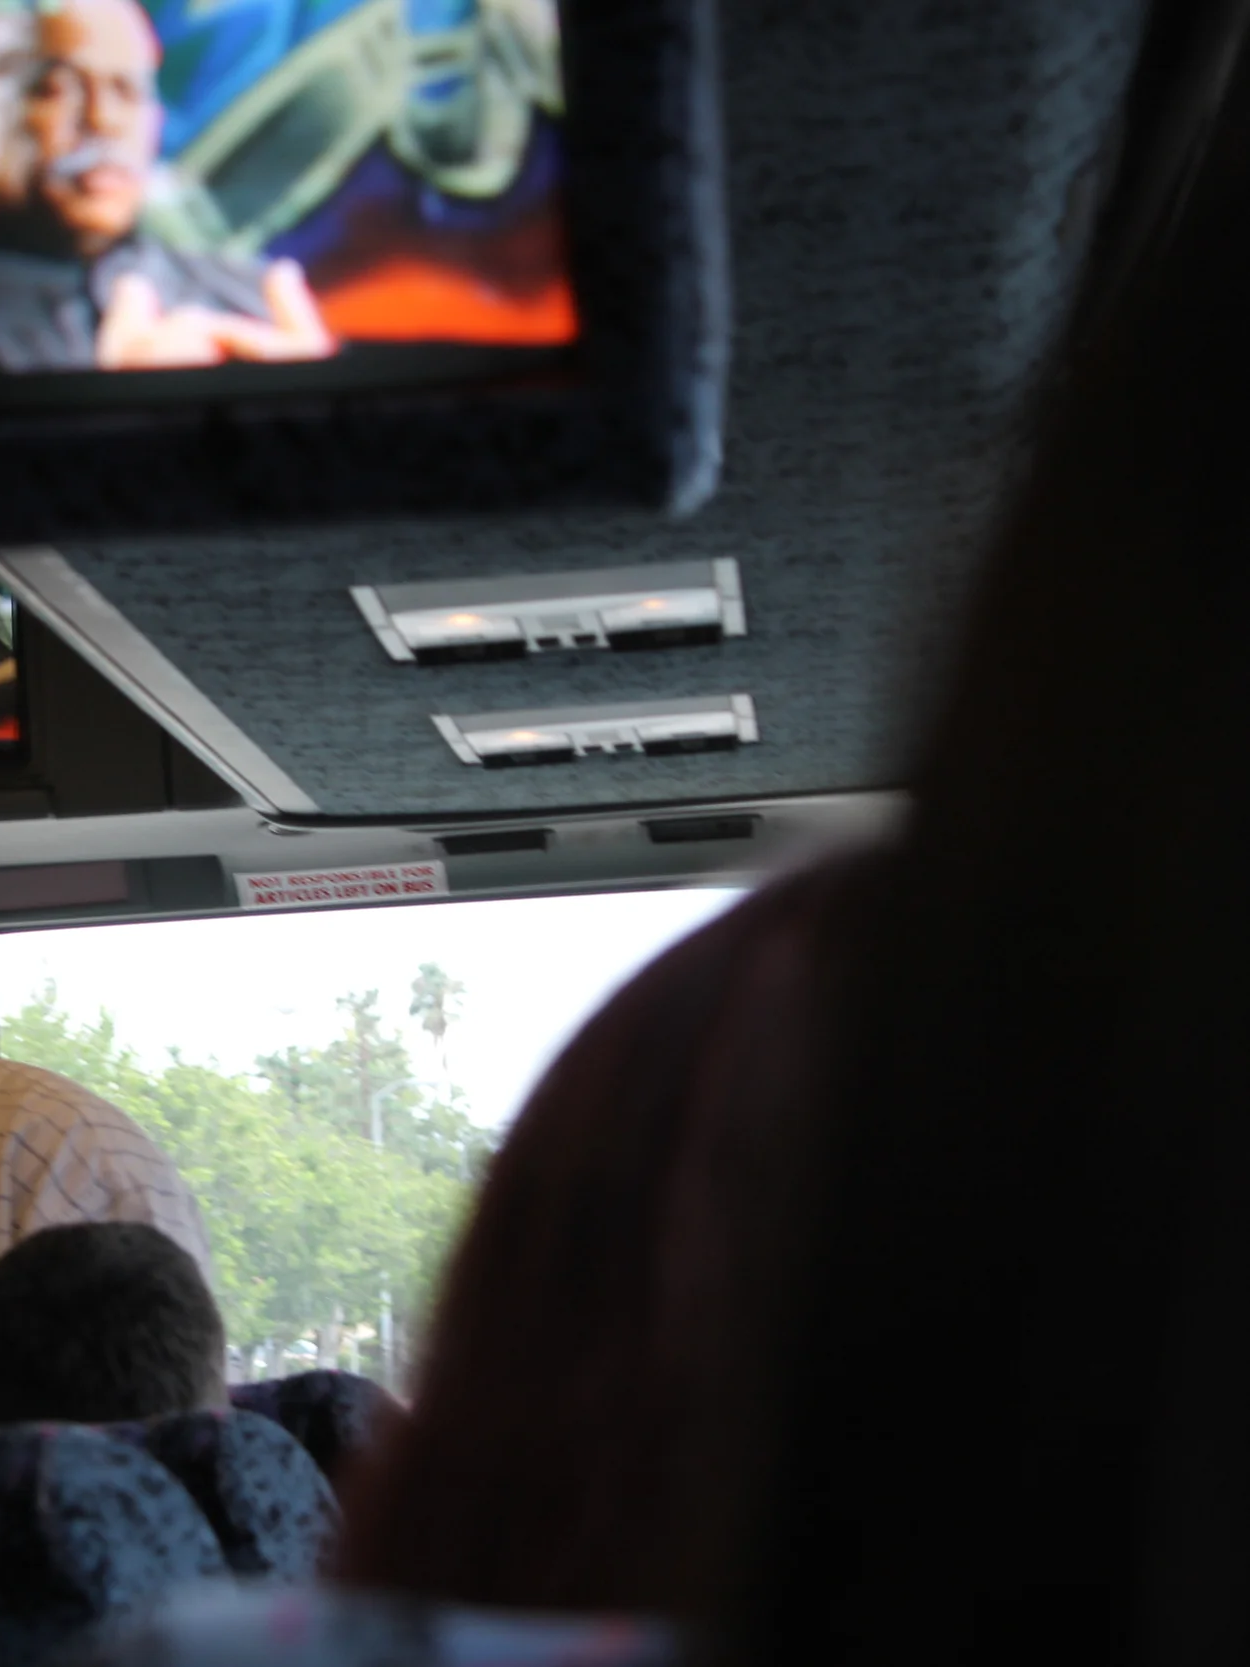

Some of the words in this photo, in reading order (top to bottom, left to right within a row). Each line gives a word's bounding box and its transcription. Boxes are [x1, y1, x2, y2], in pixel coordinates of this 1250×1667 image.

[248, 876, 282, 889] NOT
[287, 869, 397, 886] RESPONSIBLE
[401, 865, 435, 878] FOR
[254, 887, 331, 905] ARTICLES
[334, 884, 369, 899] LEFT
[372, 882, 399, 896] ON
[402, 880, 435, 894] BUS
